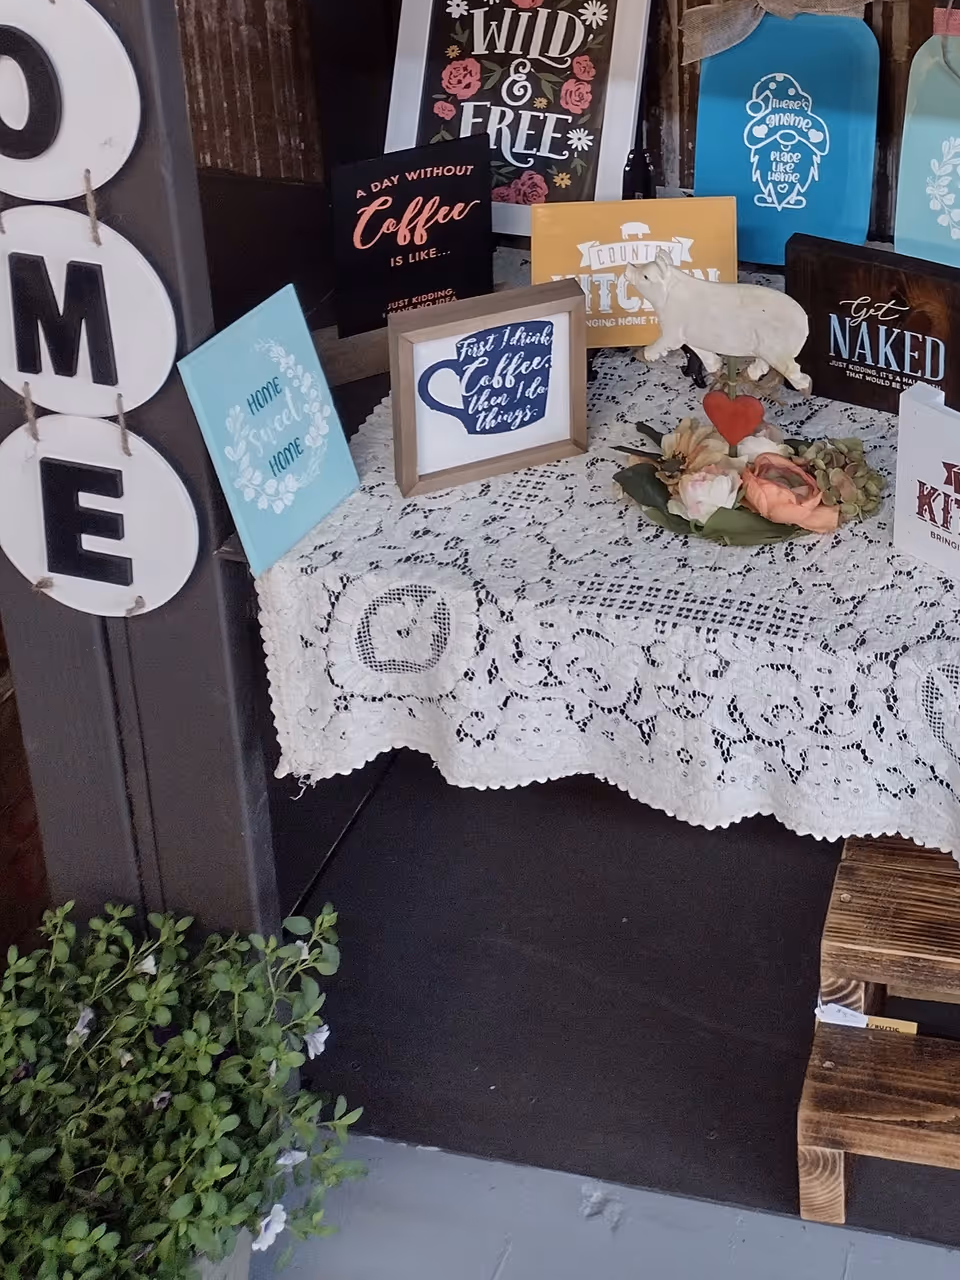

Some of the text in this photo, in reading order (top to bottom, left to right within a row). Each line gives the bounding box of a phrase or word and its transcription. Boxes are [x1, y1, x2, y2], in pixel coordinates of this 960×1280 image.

[470, 7, 585, 68] WILD
[501, 58, 533, 106] &
[459, 101, 573, 168] FREE
[766, 112, 812, 132] gnome
[356, 165, 474, 199] A DAY WITHOUT
[353, 196, 481, 250] Coffee
[391, 248, 451, 267] IS LIKE...
[387, 298, 409, 310] JUST
[618, 315, 647, 326] HOME
[839, 296, 910, 327] Get
[457, 333, 499, 362] First
[510, 324, 554, 347] drink
[828, 313, 946, 382] NAKED
[829, 360, 847, 370] JUST
[846, 371, 864, 380] THAT
[865, 375, 890, 387] WOULD
[246, 376, 282, 416] HOME
[468, 388, 509, 414] then
[268, 437, 304, 477] HOME
